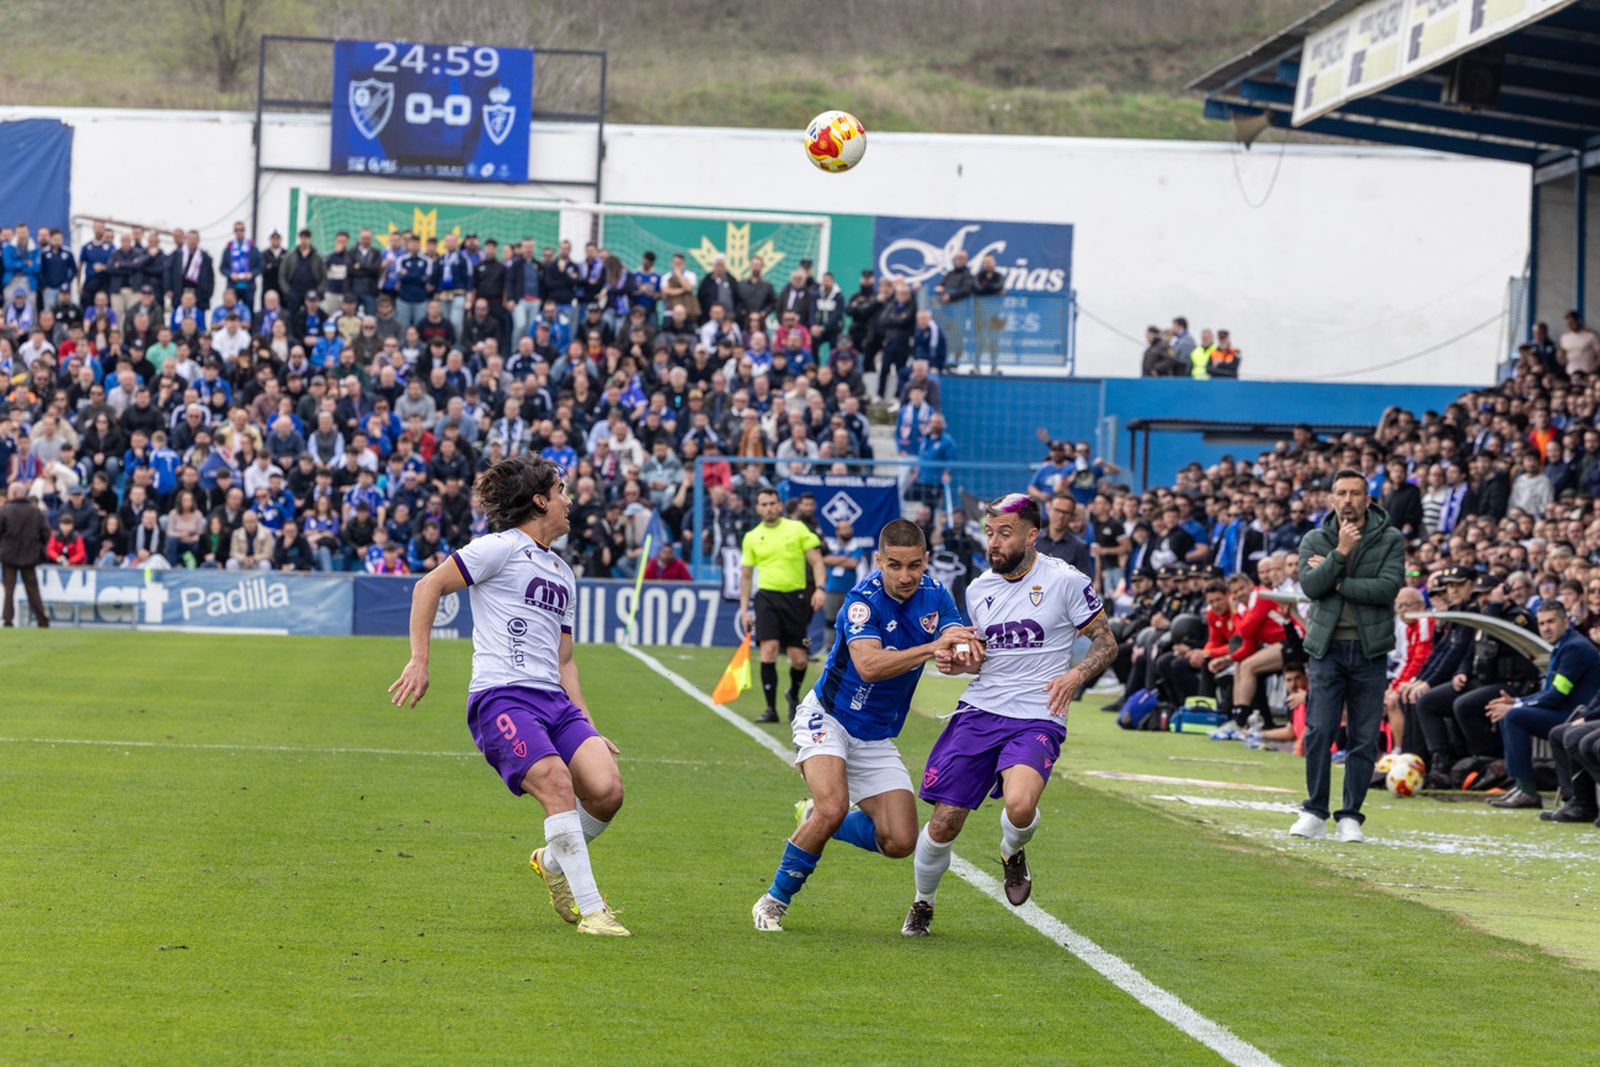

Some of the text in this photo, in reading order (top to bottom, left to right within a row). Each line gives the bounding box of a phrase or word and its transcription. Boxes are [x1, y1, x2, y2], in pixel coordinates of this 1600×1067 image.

[373, 42, 499, 77] 24:59
[405, 93, 472, 126] 0-0
[180, 577, 290, 620] Padilla
[496, 713, 517, 740] 9
[808, 713, 824, 731] 2
